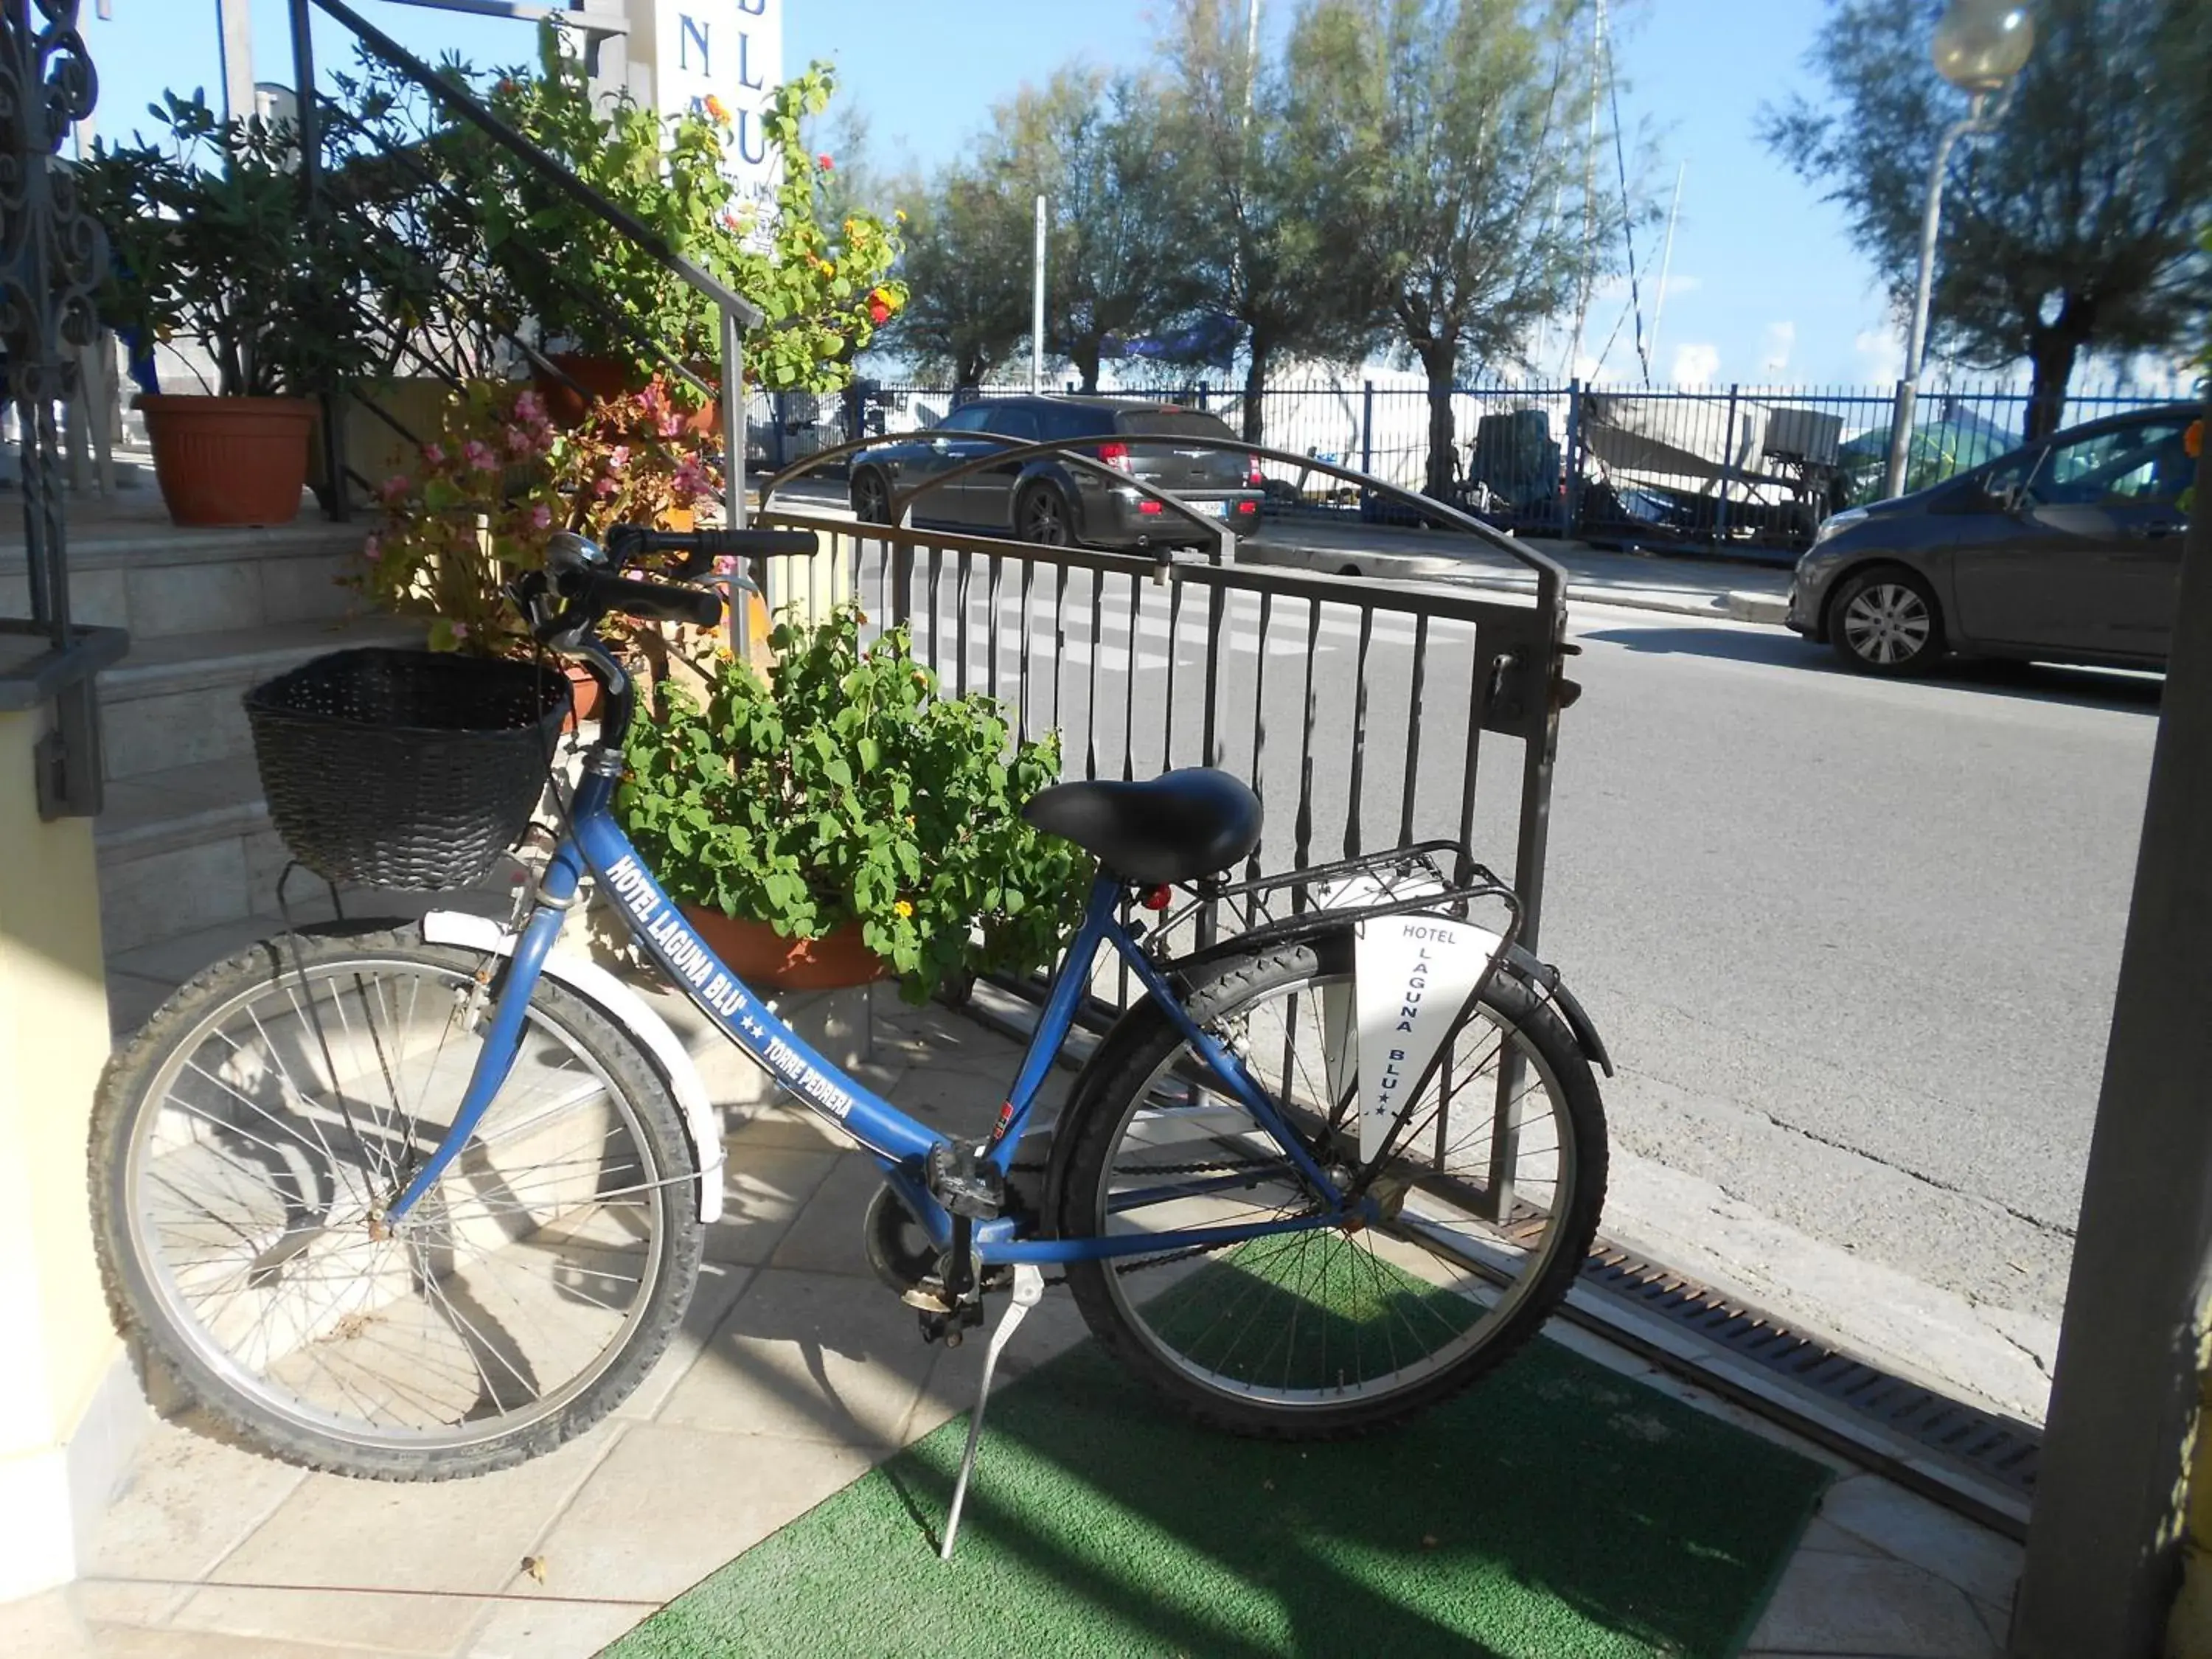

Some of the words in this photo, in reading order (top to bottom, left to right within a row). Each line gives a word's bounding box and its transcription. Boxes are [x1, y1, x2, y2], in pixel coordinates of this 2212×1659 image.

[737, 0, 765, 164] LU
[1402, 924, 1457, 945] HOTEL
[605, 855, 661, 922] HOTEL
[647, 910, 714, 988] LAGUNA
[763, 1036, 807, 1080] TORRE
[797, 1066, 853, 1119] PEDRERA
[1396, 947, 1433, 1033] LAGUNA
[1381, 1049, 1405, 1089] BLU
